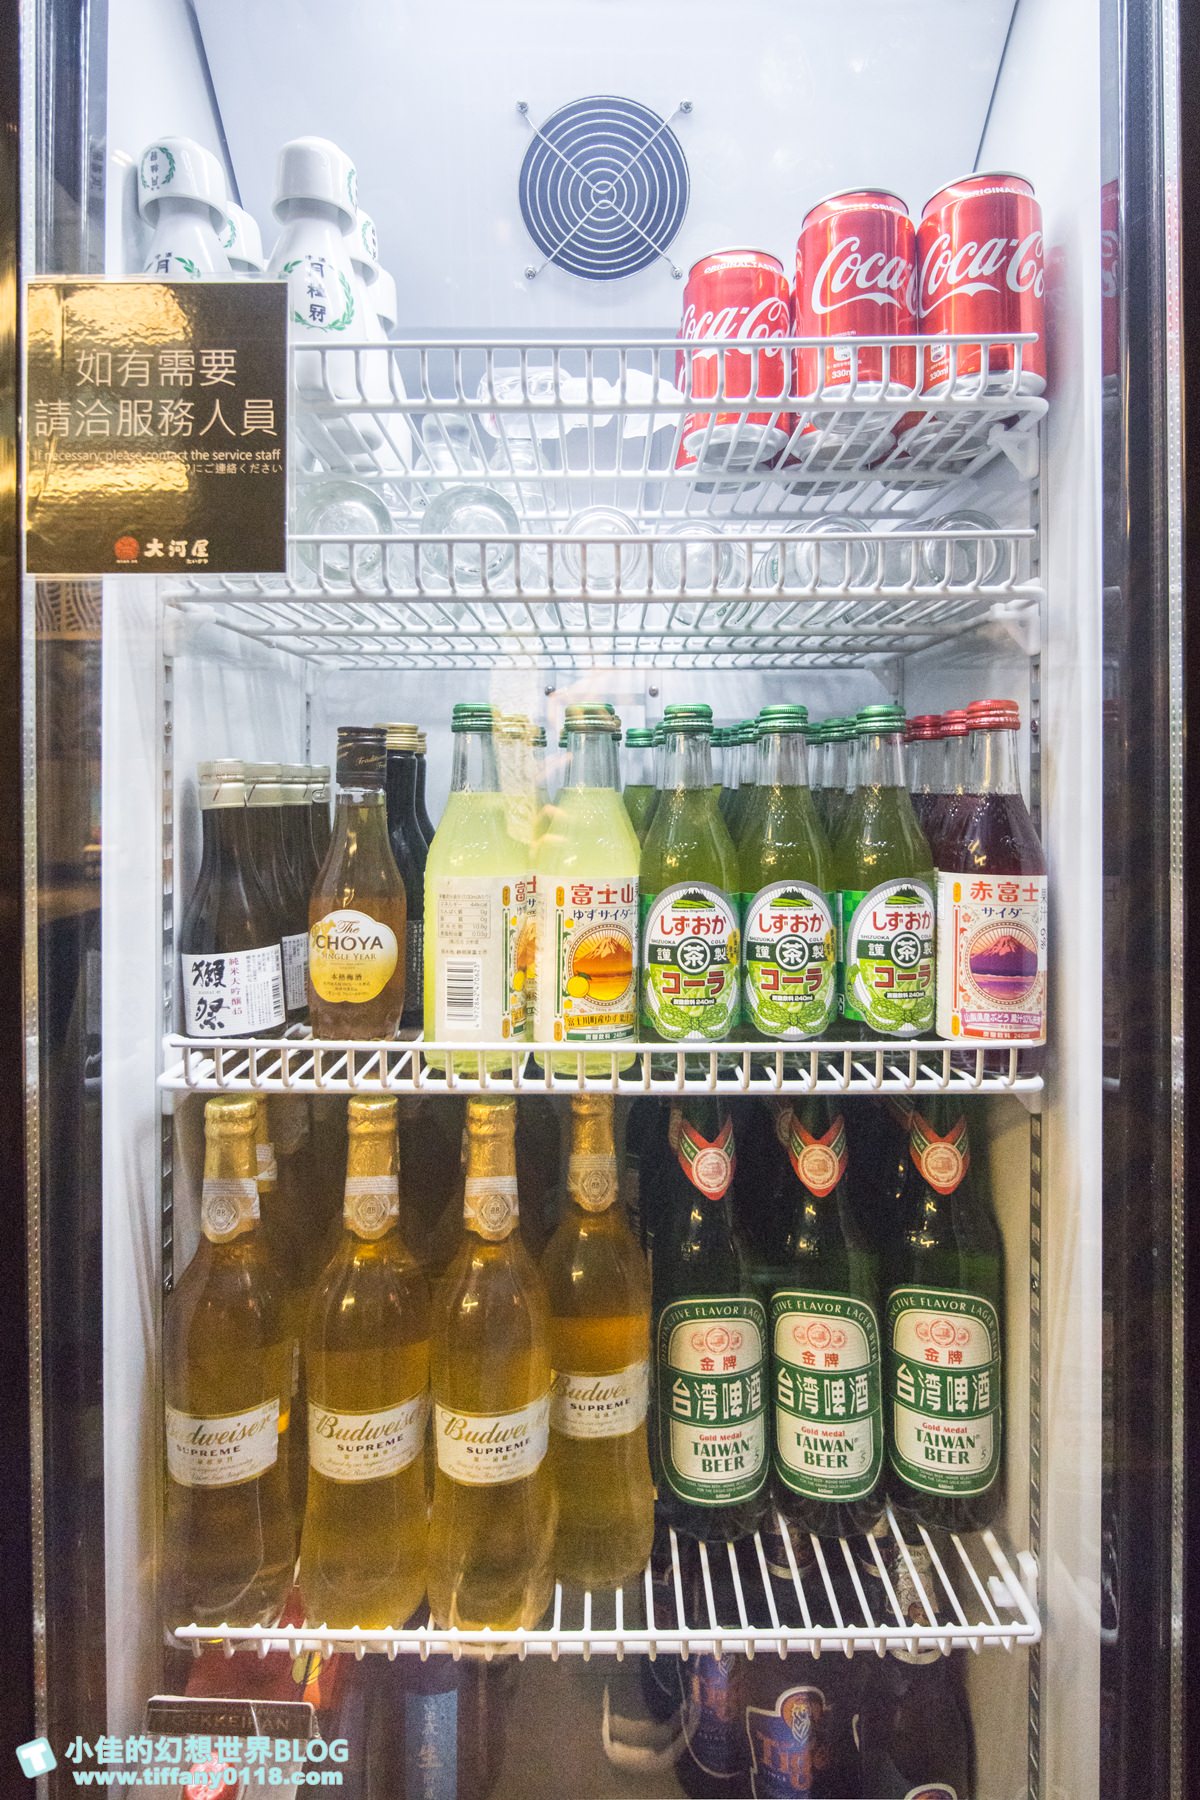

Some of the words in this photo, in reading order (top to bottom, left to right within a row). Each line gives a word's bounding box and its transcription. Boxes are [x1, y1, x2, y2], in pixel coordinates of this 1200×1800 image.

[76, 349, 238, 387] 如有需要
[34, 398, 278, 437] 請洽服務人員
[191, 449, 209, 461] the
[212, 449, 253, 461] service
[255, 449, 281, 461] staff
[144, 538, 209, 557] 大河屋
[571, 883, 634, 905] 富士山
[969, 880, 1039, 902] 赤富士
[573, 908, 637, 921] ゆずサイダー
[873, 910, 932, 931] しずおか
[981, 907, 1031, 919] サイダー
[335, 920, 360, 935] The
[660, 914, 727, 936] しずおか
[759, 912, 825, 934] しずおか
[315, 935, 384, 951] CHOYA
[867, 942, 886, 957] 謹
[897, 939, 916, 961] 茶
[353, 952, 377, 960] YEAR
[656, 947, 672, 962] 謹
[683, 944, 705, 967] 茶
[714, 947, 727, 962] 製
[755, 944, 771, 959] 謹
[782, 942, 803, 964] 茶
[661, 970, 725, 995] コーラ
[760, 967, 823, 992] コーラ
[874, 963, 931, 989] コーラ
[695, 1306, 739, 1316] FLAVOR
[920, 1297, 967, 1312] FLAVOR
[797, 1299, 842, 1313] FLAVOR
[846, 1306, 872, 1331] LAGER
[700, 1354, 737, 1372] 金牌
[801, 1350, 839, 1368] 金牌
[924, 1347, 963, 1365] 金牌
[570, 1397, 632, 1412] SUPREME
[699, 1434, 717, 1442] Gold
[719, 1431, 743, 1442] Medal
[801, 1425, 819, 1437] Gold
[821, 1428, 846, 1438] Medal
[922, 1421, 941, 1433] Gold
[943, 1425, 968, 1434] Medal
[337, 1434, 404, 1453] SUPREME
[466, 1437, 532, 1455] SUPREME
[794, 1431, 855, 1452] TAIWAN
[914, 1427, 976, 1449] TAIWAN
[176, 1443, 241, 1457] SUPREME
[691, 1439, 751, 1458] TAIWAN
[924, 1447, 970, 1465] BEER
[701, 1456, 745, 1473] BEER
[803, 1450, 849, 1468] BEER
